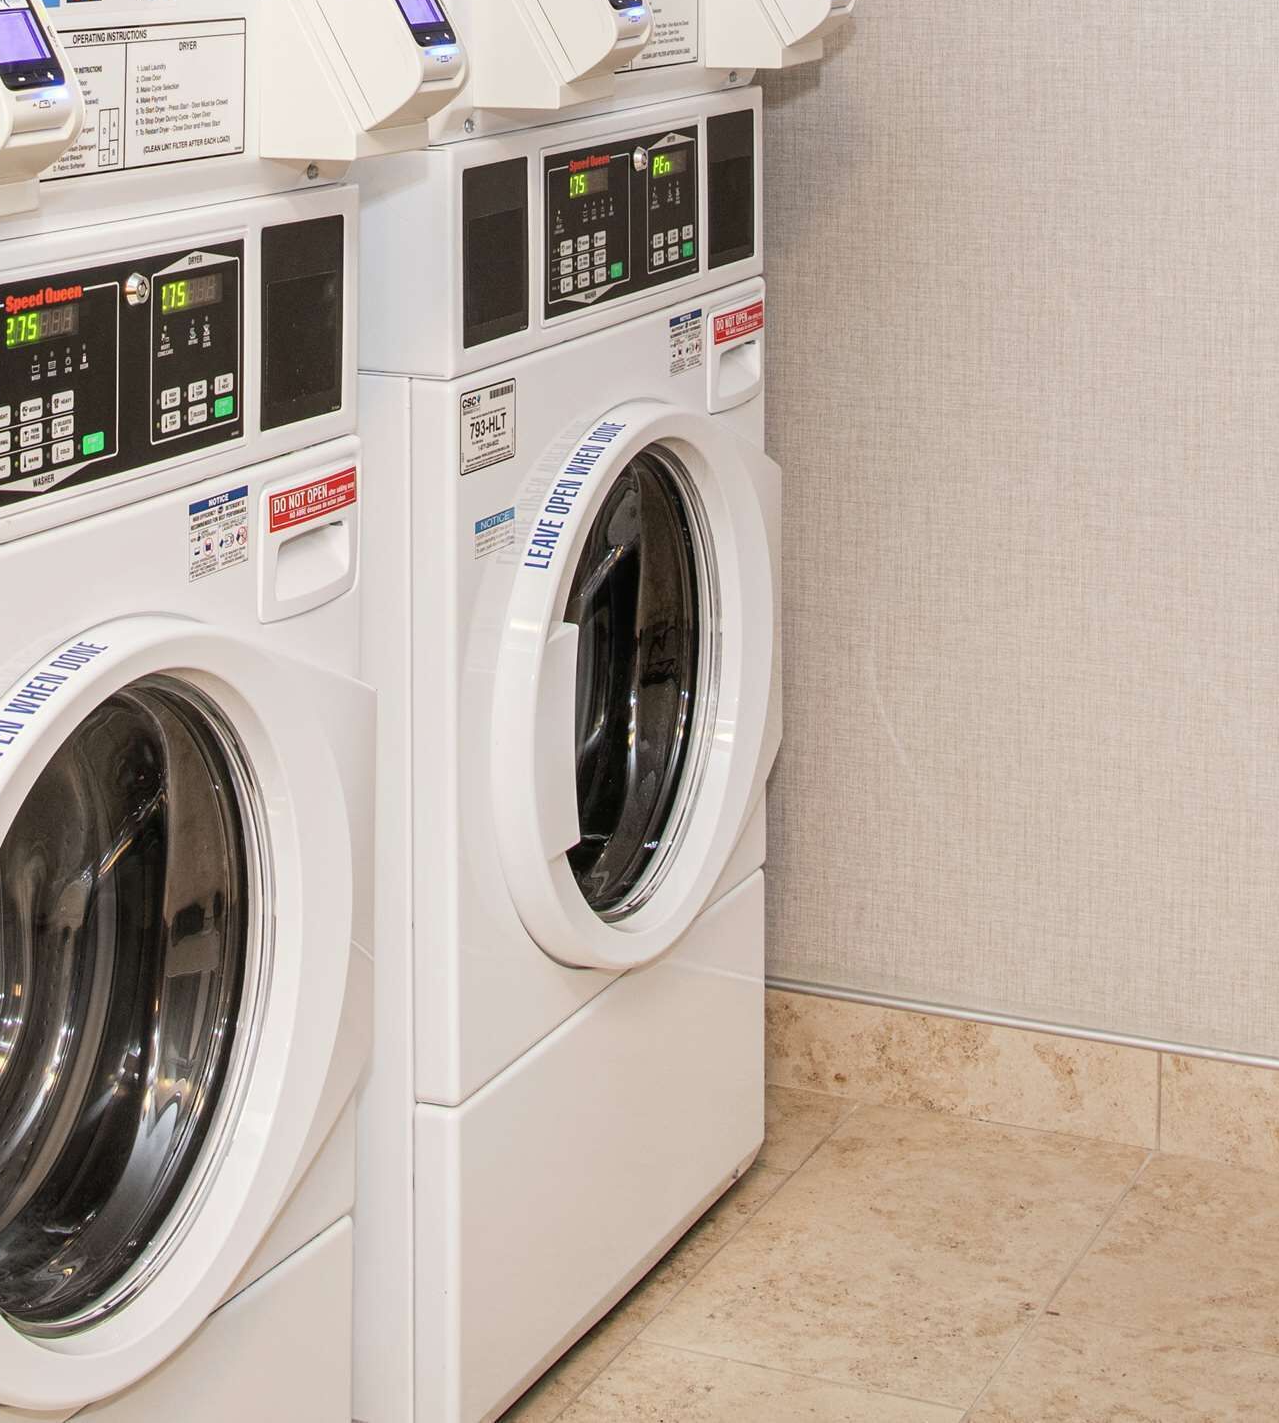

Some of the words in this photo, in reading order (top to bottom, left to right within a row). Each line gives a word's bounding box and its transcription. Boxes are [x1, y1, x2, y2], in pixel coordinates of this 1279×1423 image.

[73, 32, 105, 44] OPERATING
[107, 30, 147, 42] INSTRUCTIONS
[179, 41, 197, 51] DRYER
[188, 254, 203, 265] DRYER
[5, 288, 43, 314] Speed
[45, 285, 83, 304] Queen
[462, 397, 476, 408] CSC
[470, 412, 506, 440] 793-HLT
[33, 474, 55, 487] WASHER
[209, 494, 229, 506] NOTICE
[274, 498, 286, 514] DO
[289, 492, 305, 509] NOT
[307, 483, 327, 503] OPEN
[524, 519, 563, 569] LEAVE
[545, 479, 583, 515] OPEN
[564, 444, 606, 475] WHEN
[588, 422, 626, 443] DONE
[480, 511, 510, 530] NOTICE
[4, 672, 69, 715] WHEN
[49, 641, 108, 671] DONE
